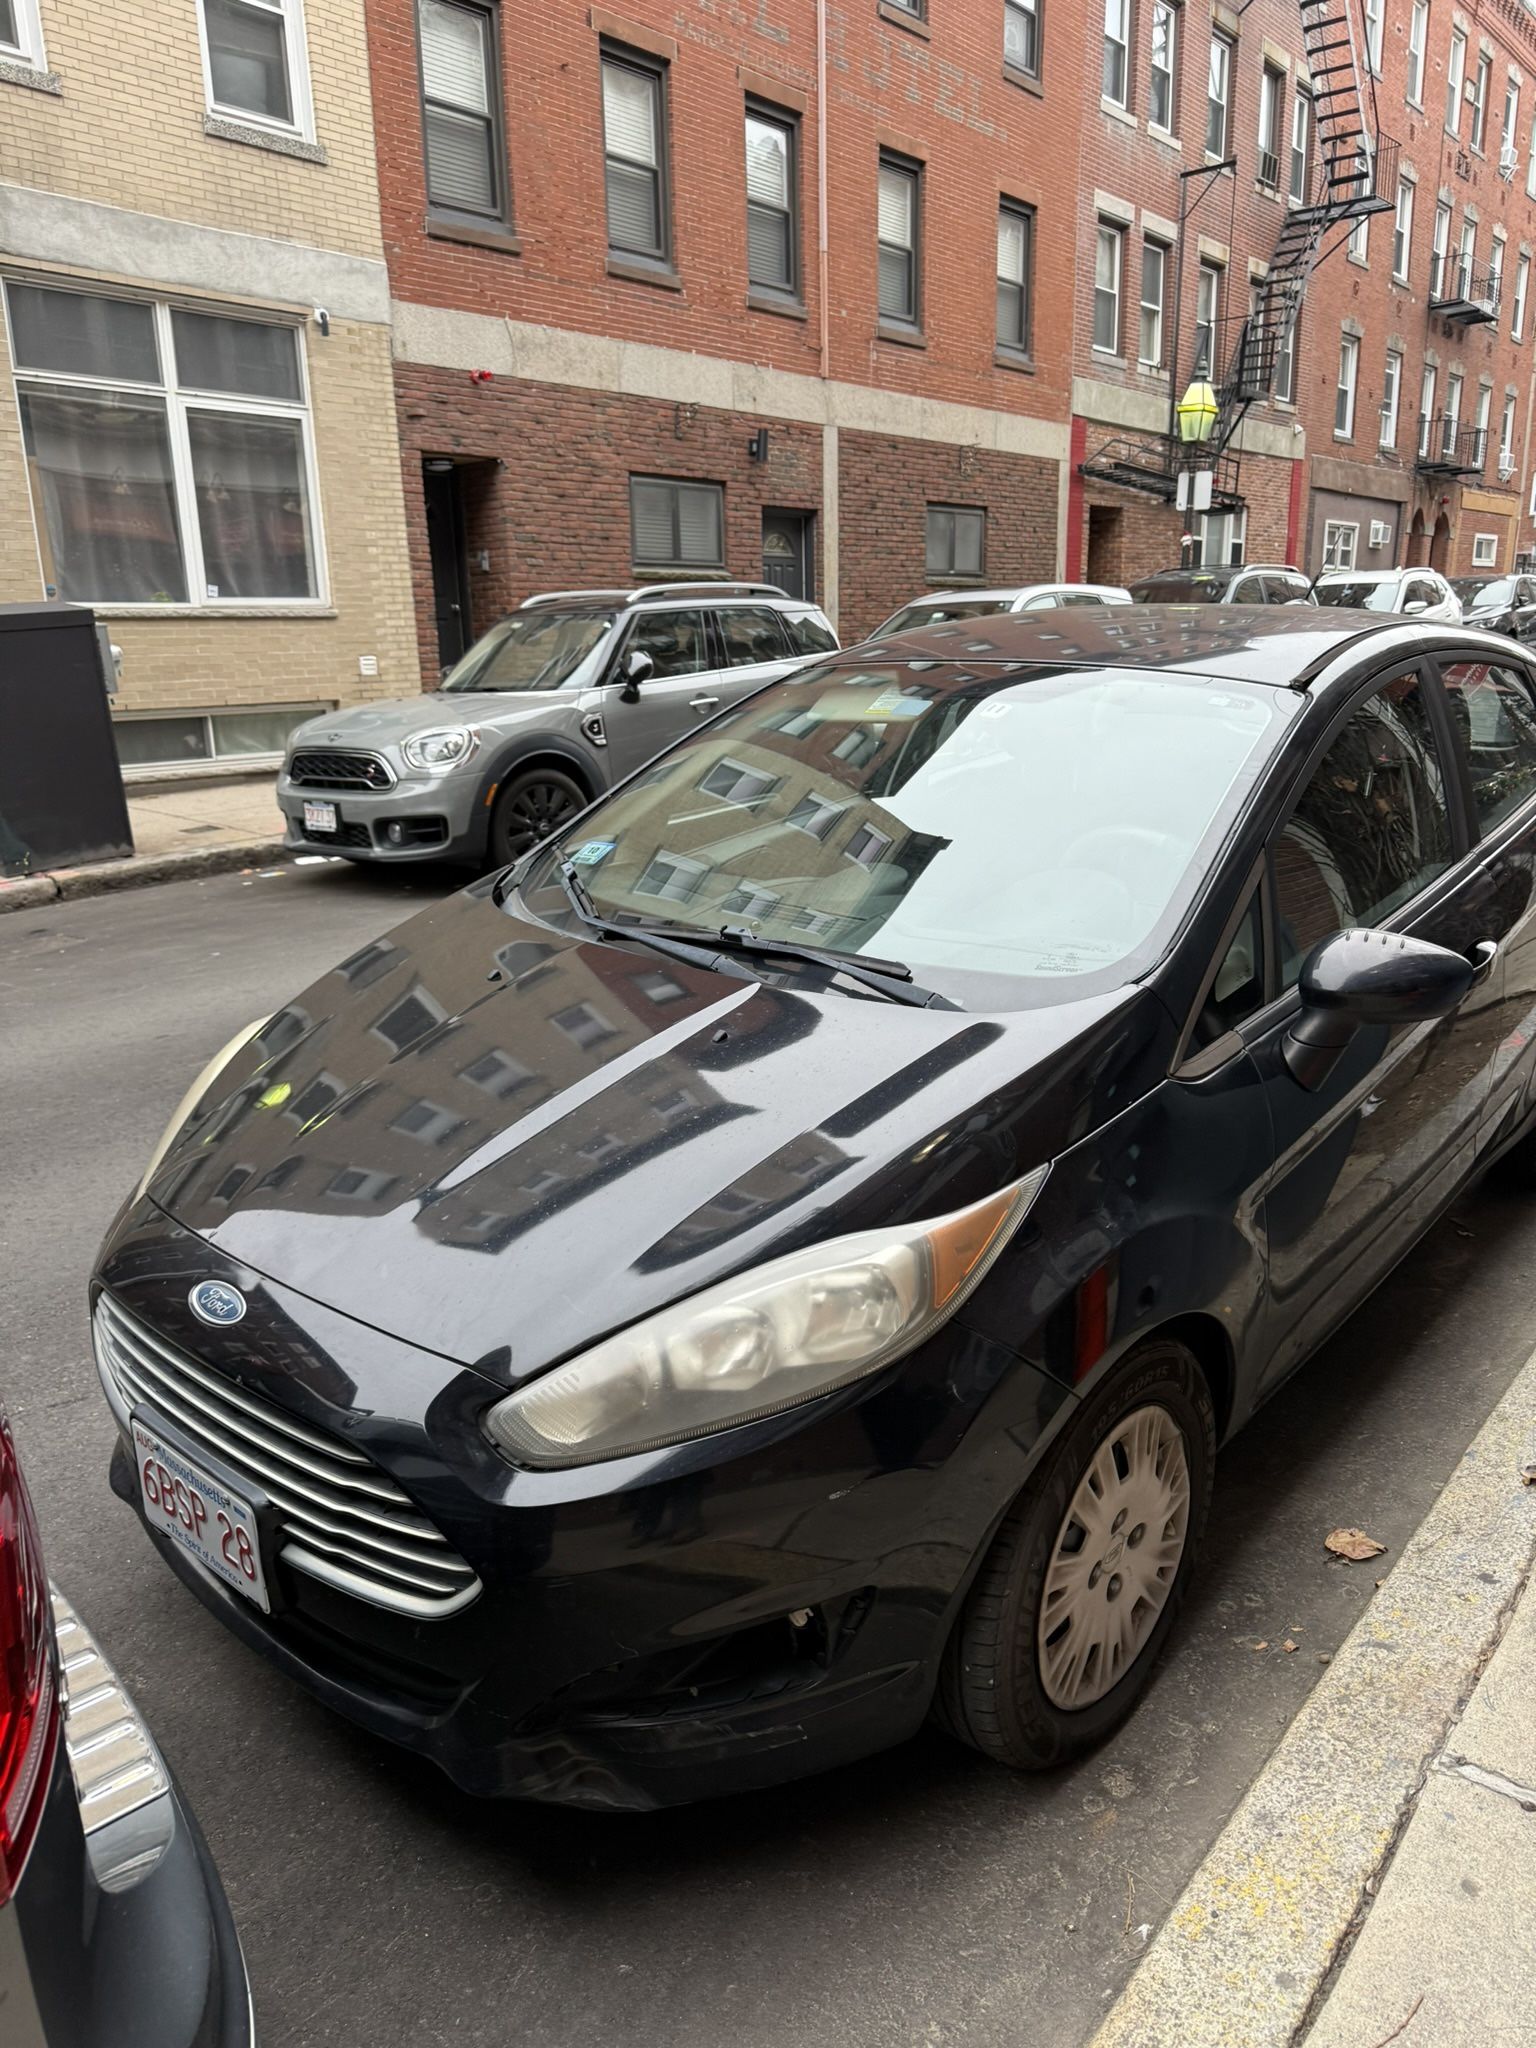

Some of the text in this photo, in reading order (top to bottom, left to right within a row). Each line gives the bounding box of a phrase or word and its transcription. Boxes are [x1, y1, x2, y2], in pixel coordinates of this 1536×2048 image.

[201, 1287, 234, 1316] Ford
[157, 1445, 227, 1508] Massachusetts
[143, 1455, 256, 1582] 6BSP 28
[170, 1522, 237, 1582] The Spirit of America
